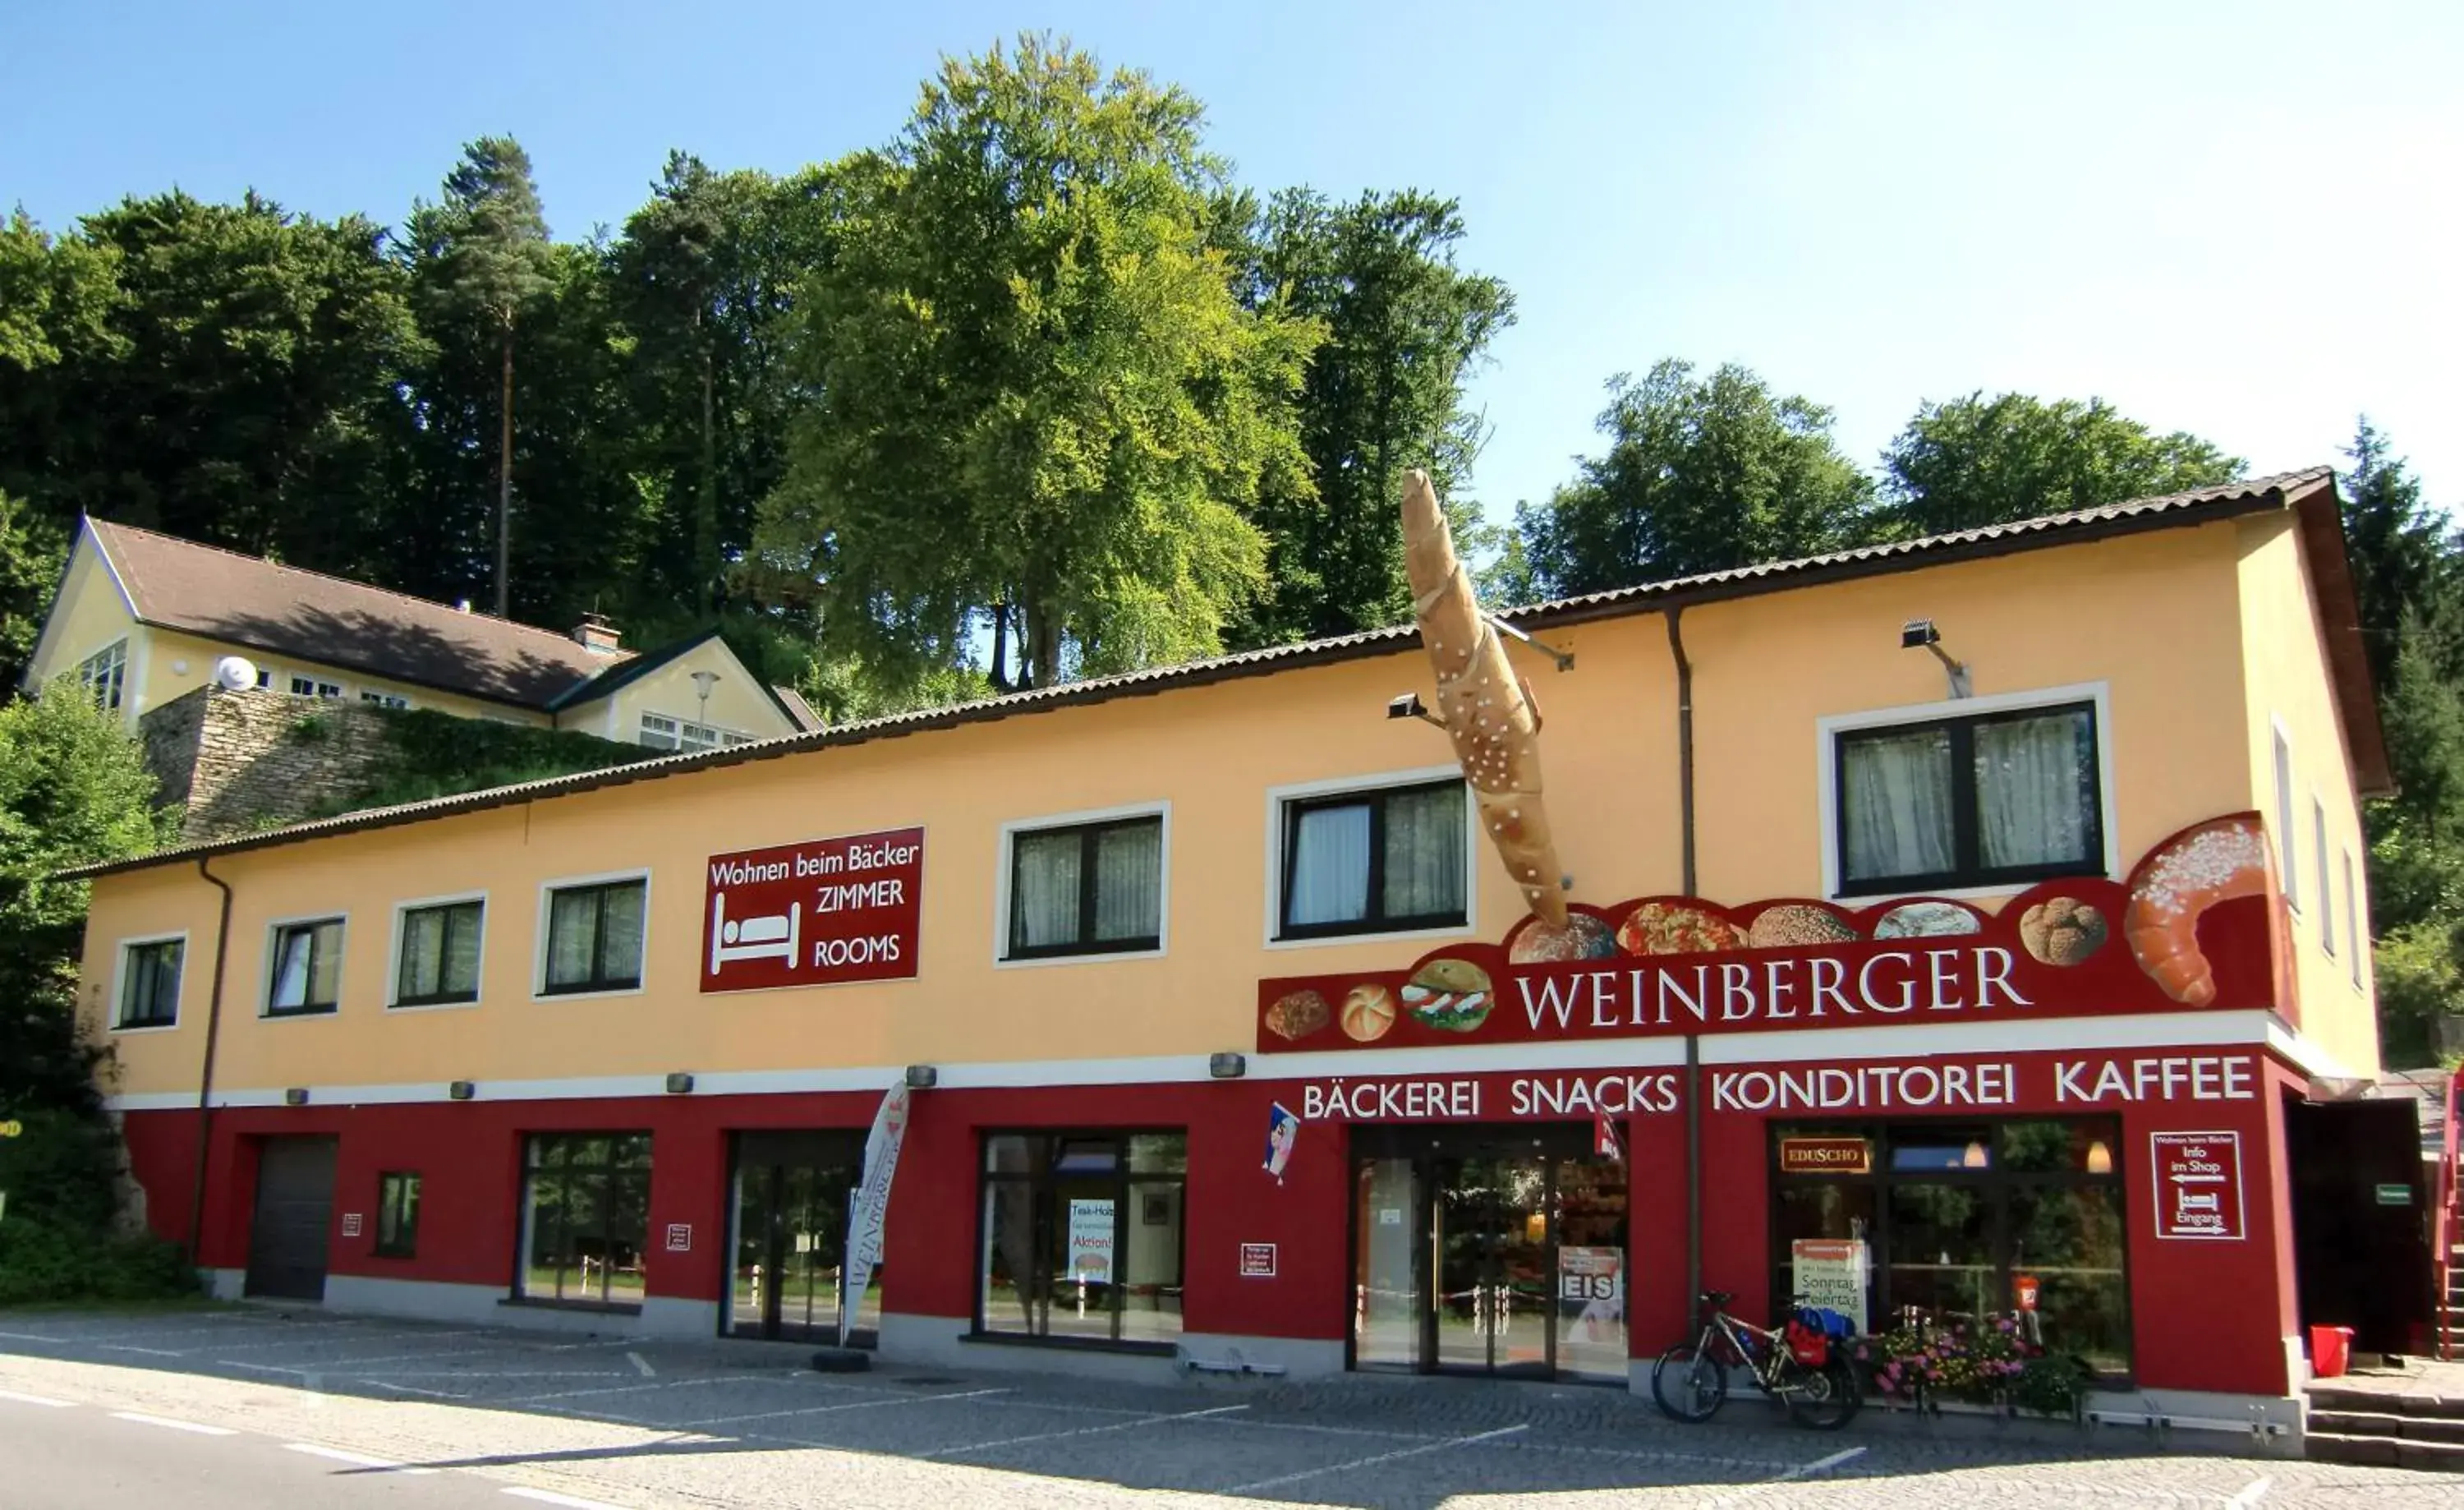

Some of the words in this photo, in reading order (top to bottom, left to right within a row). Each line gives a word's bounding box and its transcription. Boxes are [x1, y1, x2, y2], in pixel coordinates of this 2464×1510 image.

[711, 859, 789, 886] Wohnen
[796, 851, 843, 877] beim
[848, 840, 919, 872] Bäcker
[816, 878, 905, 914] ZIMMER
[814, 933, 900, 967] ROOMS
[1515, 945, 2034, 1031] WEINBERGER
[1303, 1076, 1479, 1119] BÄCKEREI
[1511, 1073, 1679, 1116] SNACKS
[1712, 1064, 2015, 1112] KONDITOREI
[2056, 1055, 2255, 1102] KAFFEE
[1788, 1148, 1859, 1162] EDUSCHO
[2182, 1146, 2207, 1158] Info
[2171, 1160, 2187, 1172] im
[2188, 1160, 2221, 1174] Shop
[2176, 1211, 2223, 1226] Eingang
[1073, 1235, 1111, 1249] Aktion!
[1562, 1273, 1614, 1301] EIS
